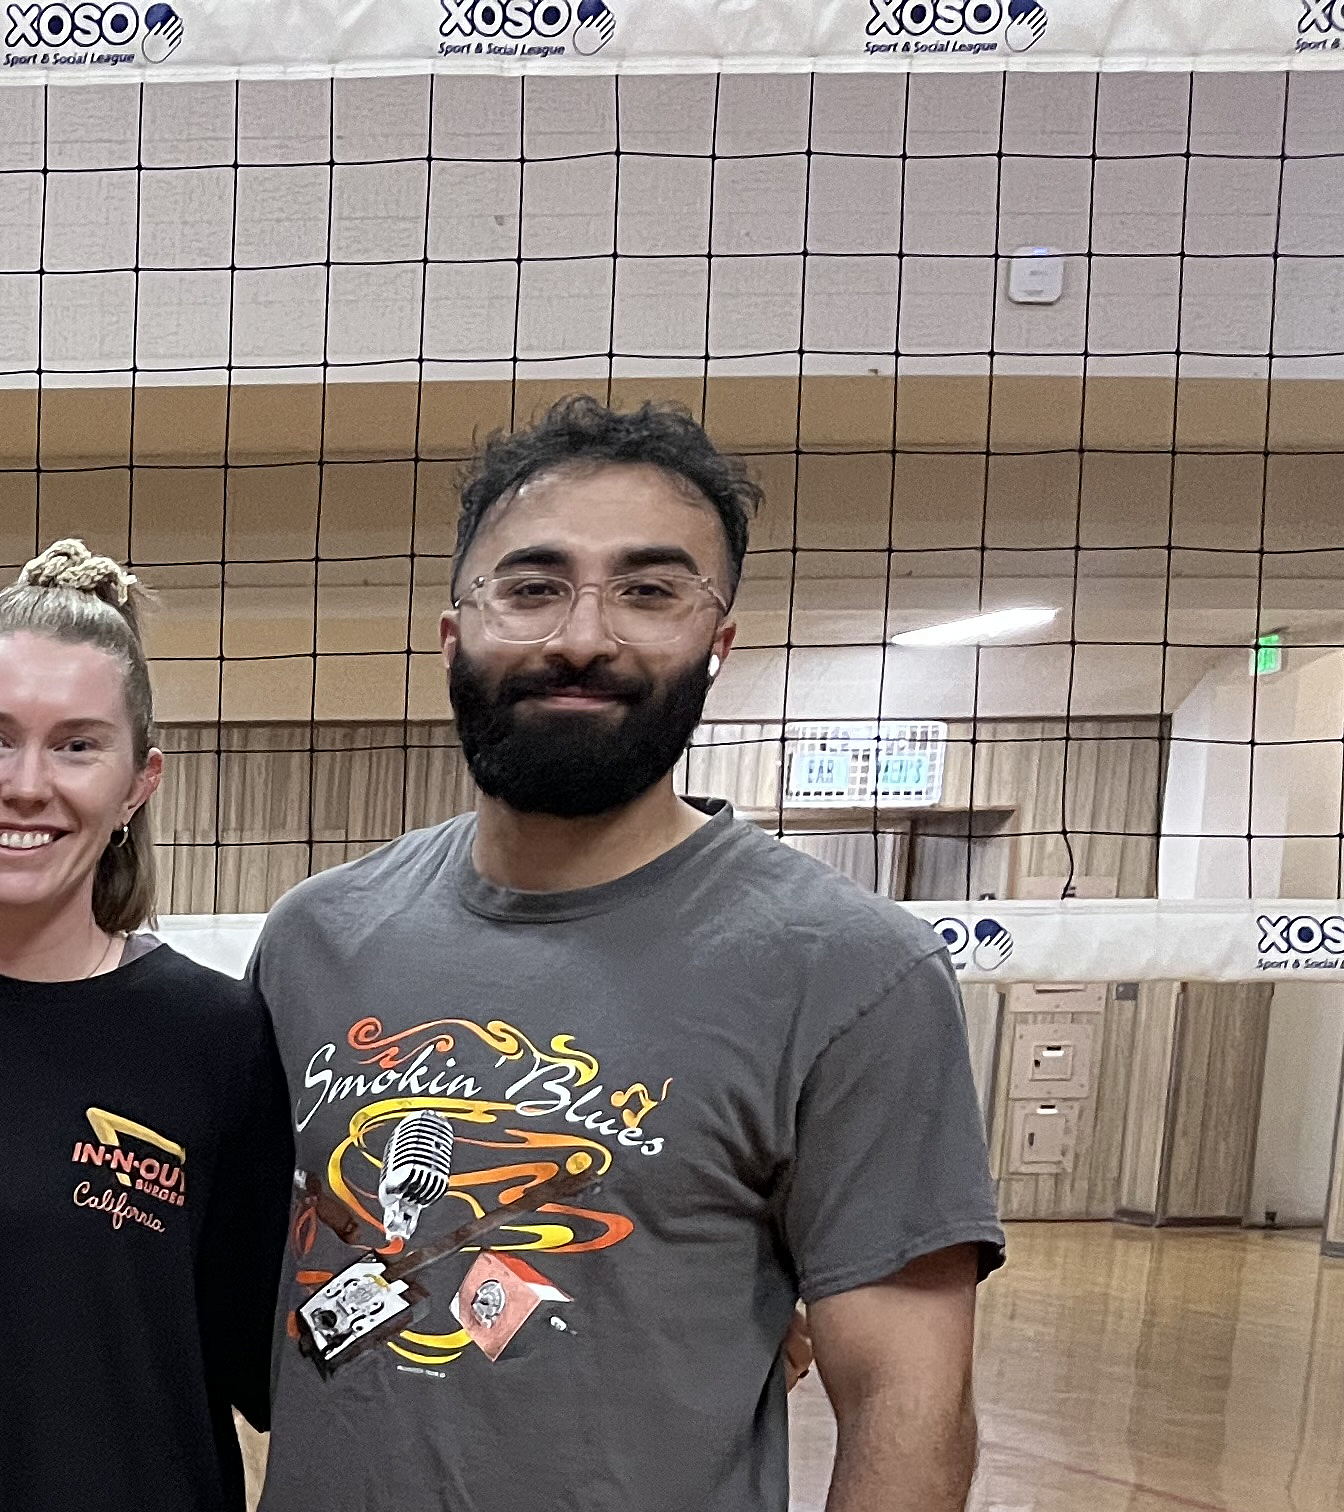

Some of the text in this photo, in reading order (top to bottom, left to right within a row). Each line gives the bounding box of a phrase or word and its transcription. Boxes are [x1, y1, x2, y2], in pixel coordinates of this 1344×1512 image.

[5, 2, 139, 47] XOSO
[439, 0, 571, 38] XOSO
[865, 0, 1002, 35] XOSO
[3, 53, 37, 66] Sport
[52, 52, 86, 64] Social
[90, 53, 134, 64] League
[439, 43, 472, 55] Sport
[487, 43, 517, 54] Social
[520, 44, 565, 56] League
[864, 41, 897, 53] Sport
[914, 40, 949, 52] Social
[952, 42, 997, 53] League
[1257, 959, 1288, 970] Sport
[1304, 959, 1336, 969] Social
[296, 1043, 664, 1156] Smokin' Blues
[73, 1181, 166, 1232] California
